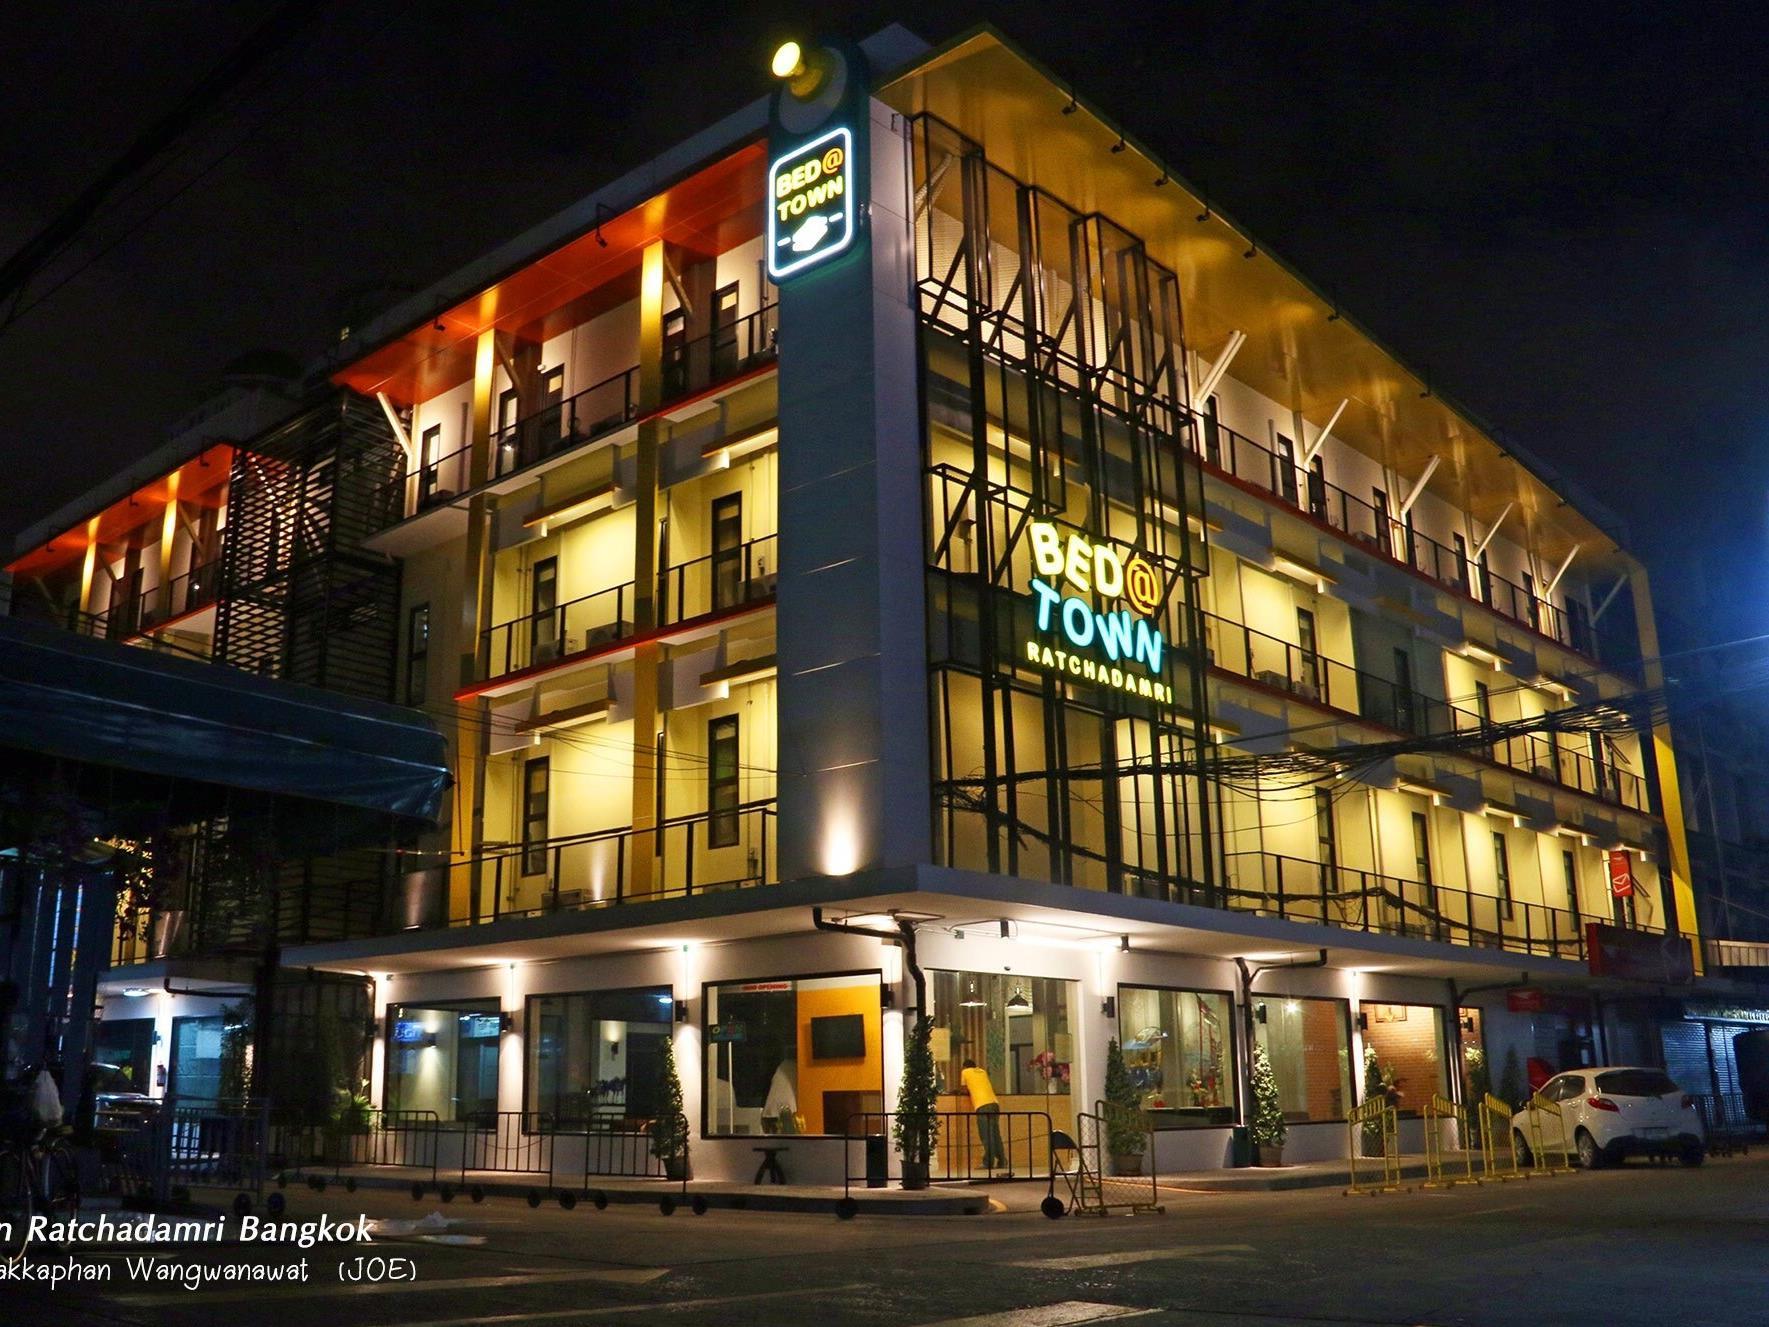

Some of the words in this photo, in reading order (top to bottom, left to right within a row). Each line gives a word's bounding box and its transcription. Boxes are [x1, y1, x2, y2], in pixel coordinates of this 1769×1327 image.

[776, 147, 843, 198] BED@
[776, 175, 843, 221] TOWN
[1029, 522, 1160, 615] BED@
[1031, 578, 1163, 674] TOWN
[1026, 641, 1173, 704] RATCHADAMRI
